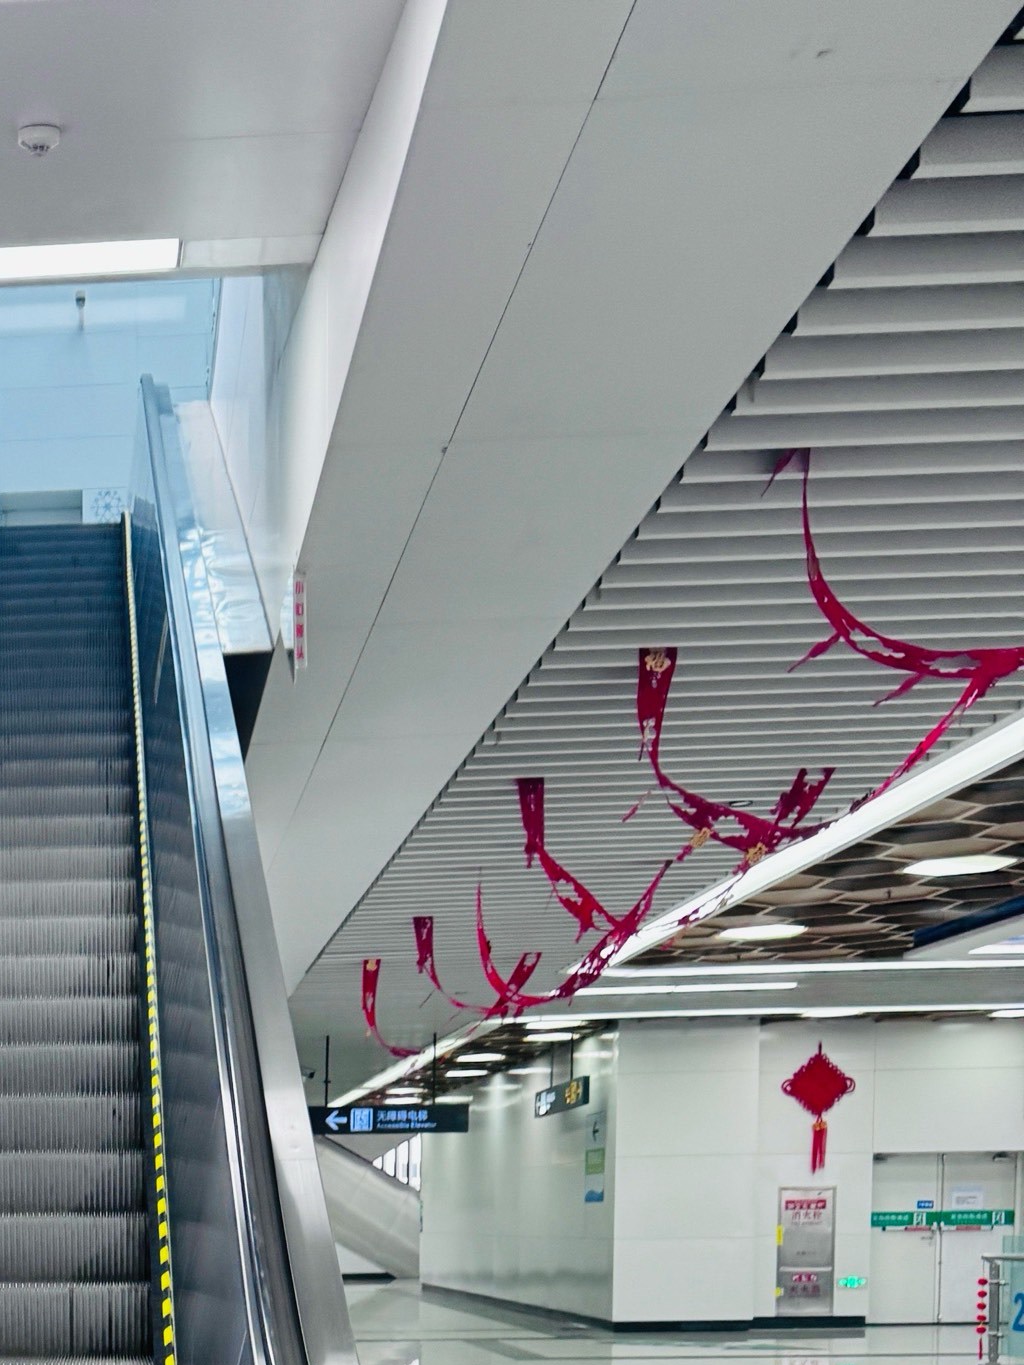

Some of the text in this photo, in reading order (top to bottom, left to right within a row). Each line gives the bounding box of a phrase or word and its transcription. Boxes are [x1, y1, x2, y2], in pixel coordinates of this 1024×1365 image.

[377, 1110, 429, 1122] 无障碍电梯
